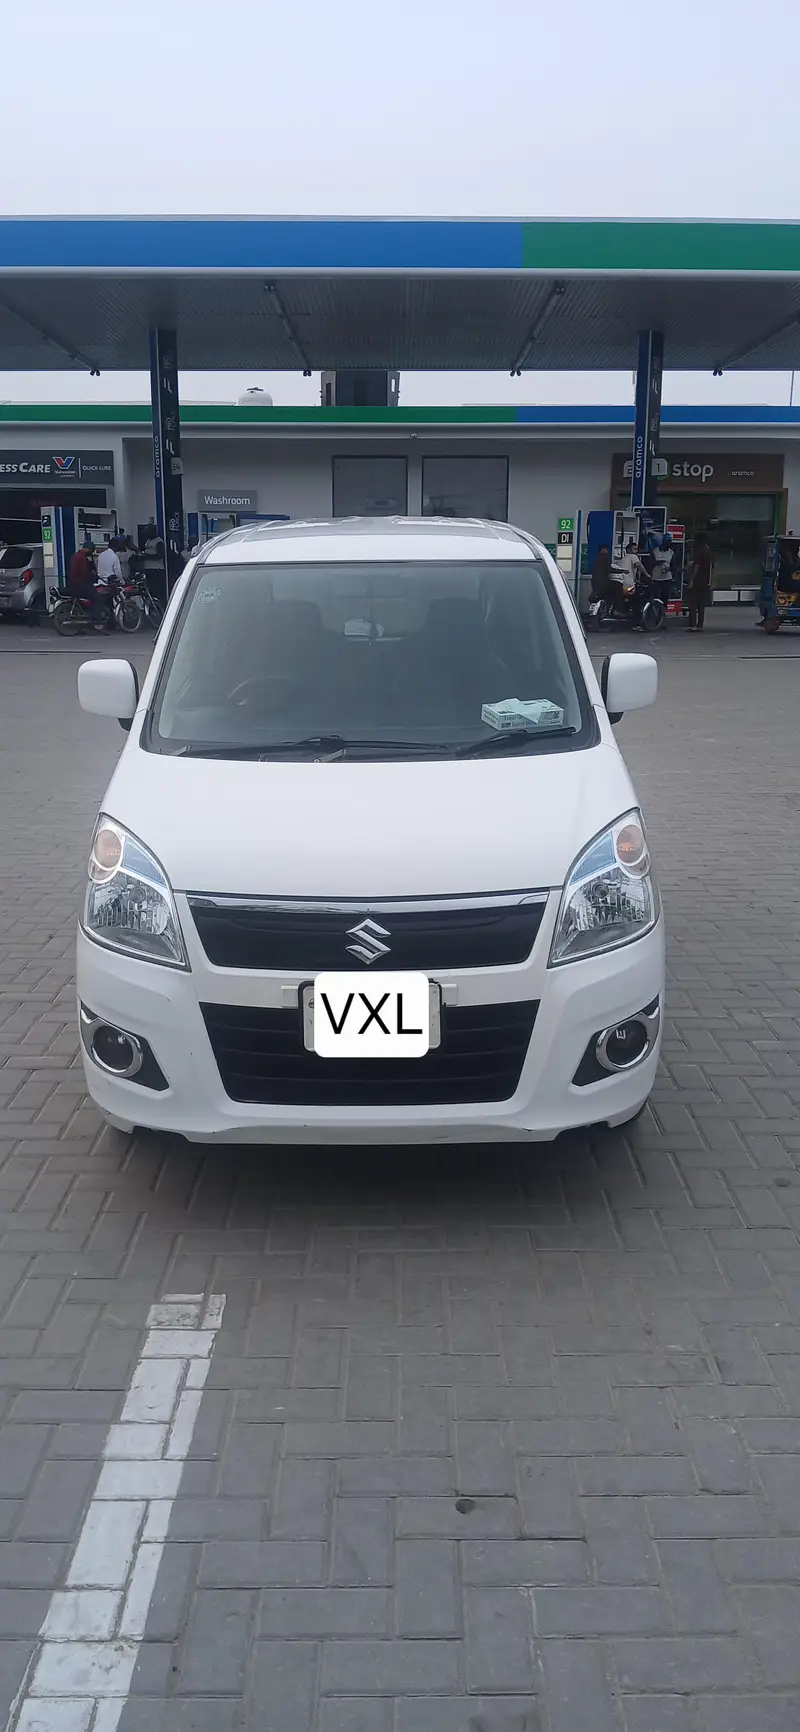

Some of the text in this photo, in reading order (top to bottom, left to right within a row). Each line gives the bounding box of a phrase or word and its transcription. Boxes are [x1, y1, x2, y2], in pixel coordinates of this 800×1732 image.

[635, 435, 643, 478] aramco
[672, 461, 714, 482] stop
[204, 495, 250, 505] Washroom
[561, 519, 571, 529] 92
[43, 530, 51, 540] 92
[561, 533, 569, 543] DI
